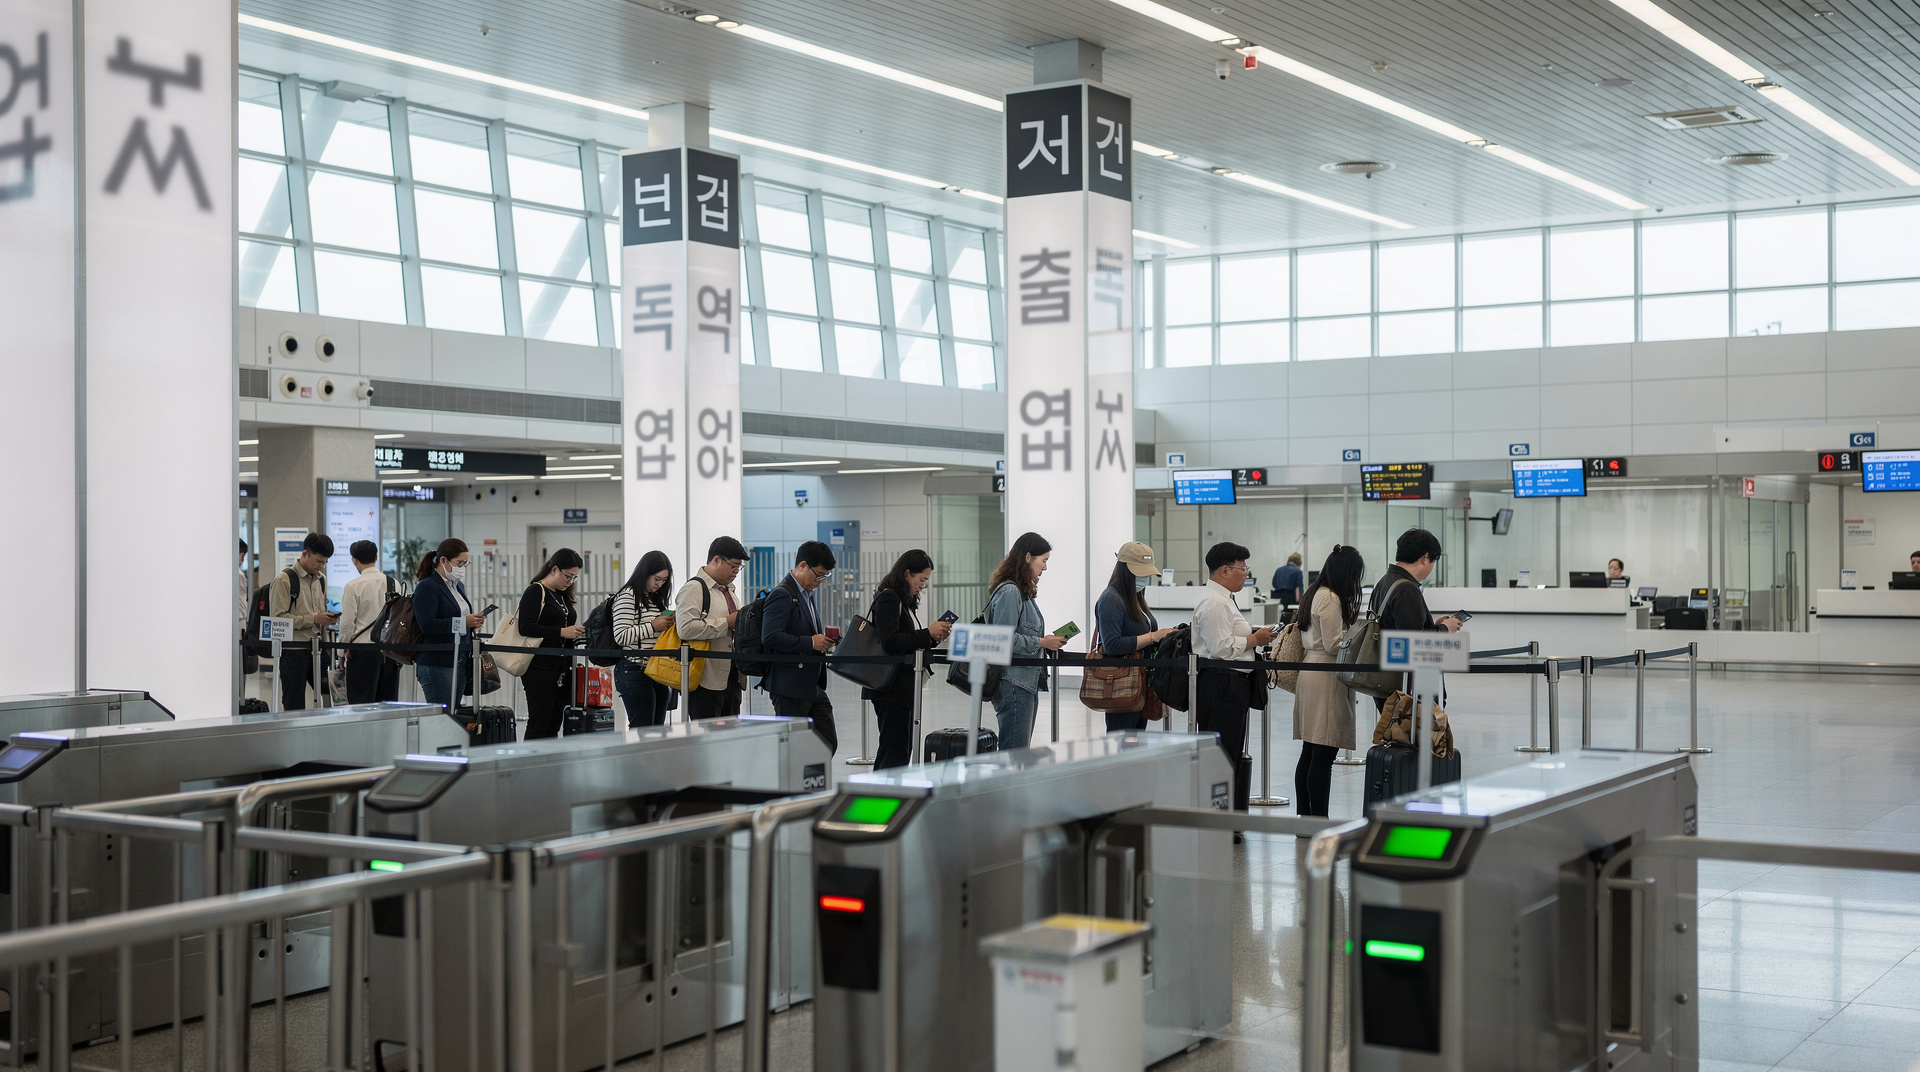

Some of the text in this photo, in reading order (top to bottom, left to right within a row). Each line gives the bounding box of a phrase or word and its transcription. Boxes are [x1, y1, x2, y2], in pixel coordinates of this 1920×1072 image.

[1017, 114, 1069, 175] 저
[1096, 116, 1123, 181] 건
[696, 174, 728, 232] 겁
